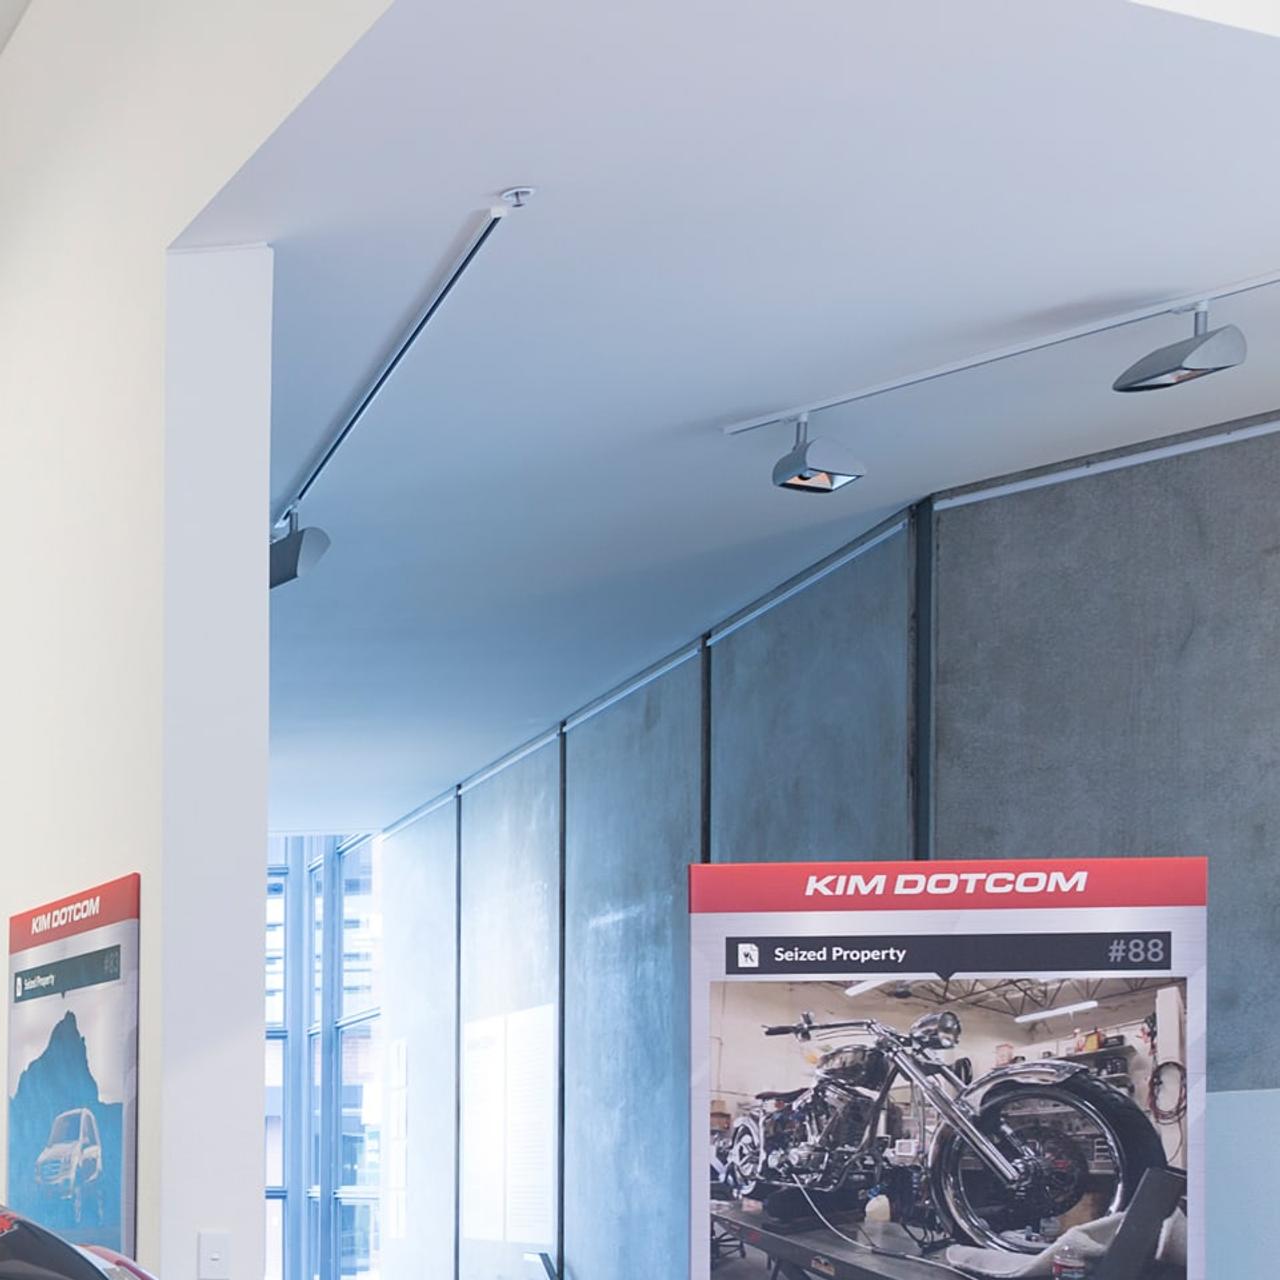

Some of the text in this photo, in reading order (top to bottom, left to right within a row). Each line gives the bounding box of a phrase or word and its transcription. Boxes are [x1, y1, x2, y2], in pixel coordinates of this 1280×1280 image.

[804, 871, 1088, 896] KIM DOTCOM
[31, 896, 101, 935] KIM DOTCOM
[773, 939, 1165, 966] Seized Property #88
